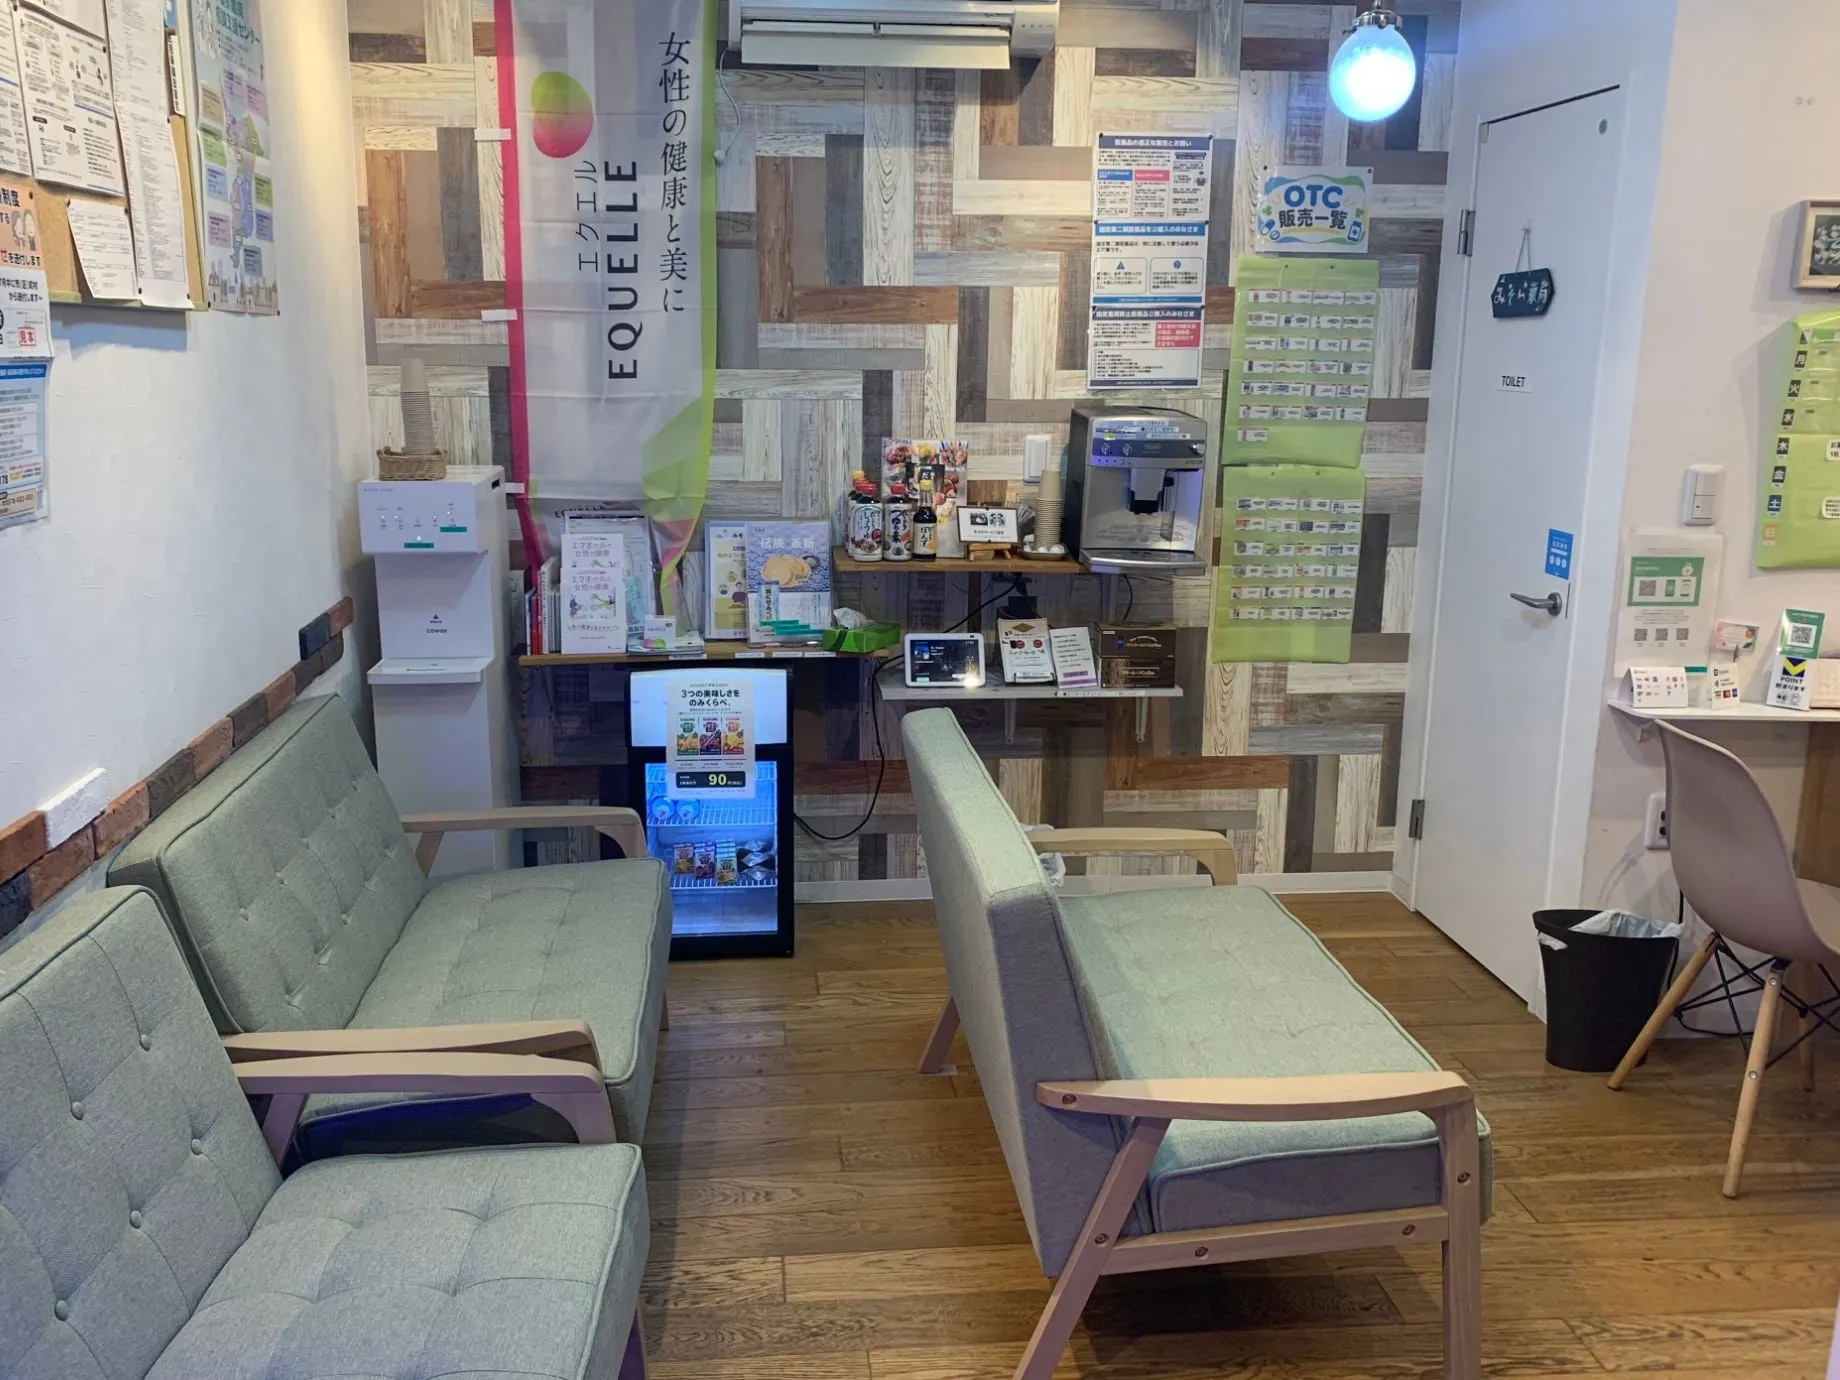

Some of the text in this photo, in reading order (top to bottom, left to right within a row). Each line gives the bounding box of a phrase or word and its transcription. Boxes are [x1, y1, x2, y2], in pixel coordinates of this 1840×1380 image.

[658, 32, 690, 313] 女性の健康と美に
[0, 187, 20, 207] 制度
[1284, 184, 1344, 209] OTC
[574, 160, 600, 272] エクエル
[1279, 209, 1349, 230] 販売一覧
[604, 161, 643, 379] EQUELLE
[1502, 375, 1526, 387] TOILET
[681, 689, 741, 698] 3つの美味しさを
[708, 774, 727, 785] 90
